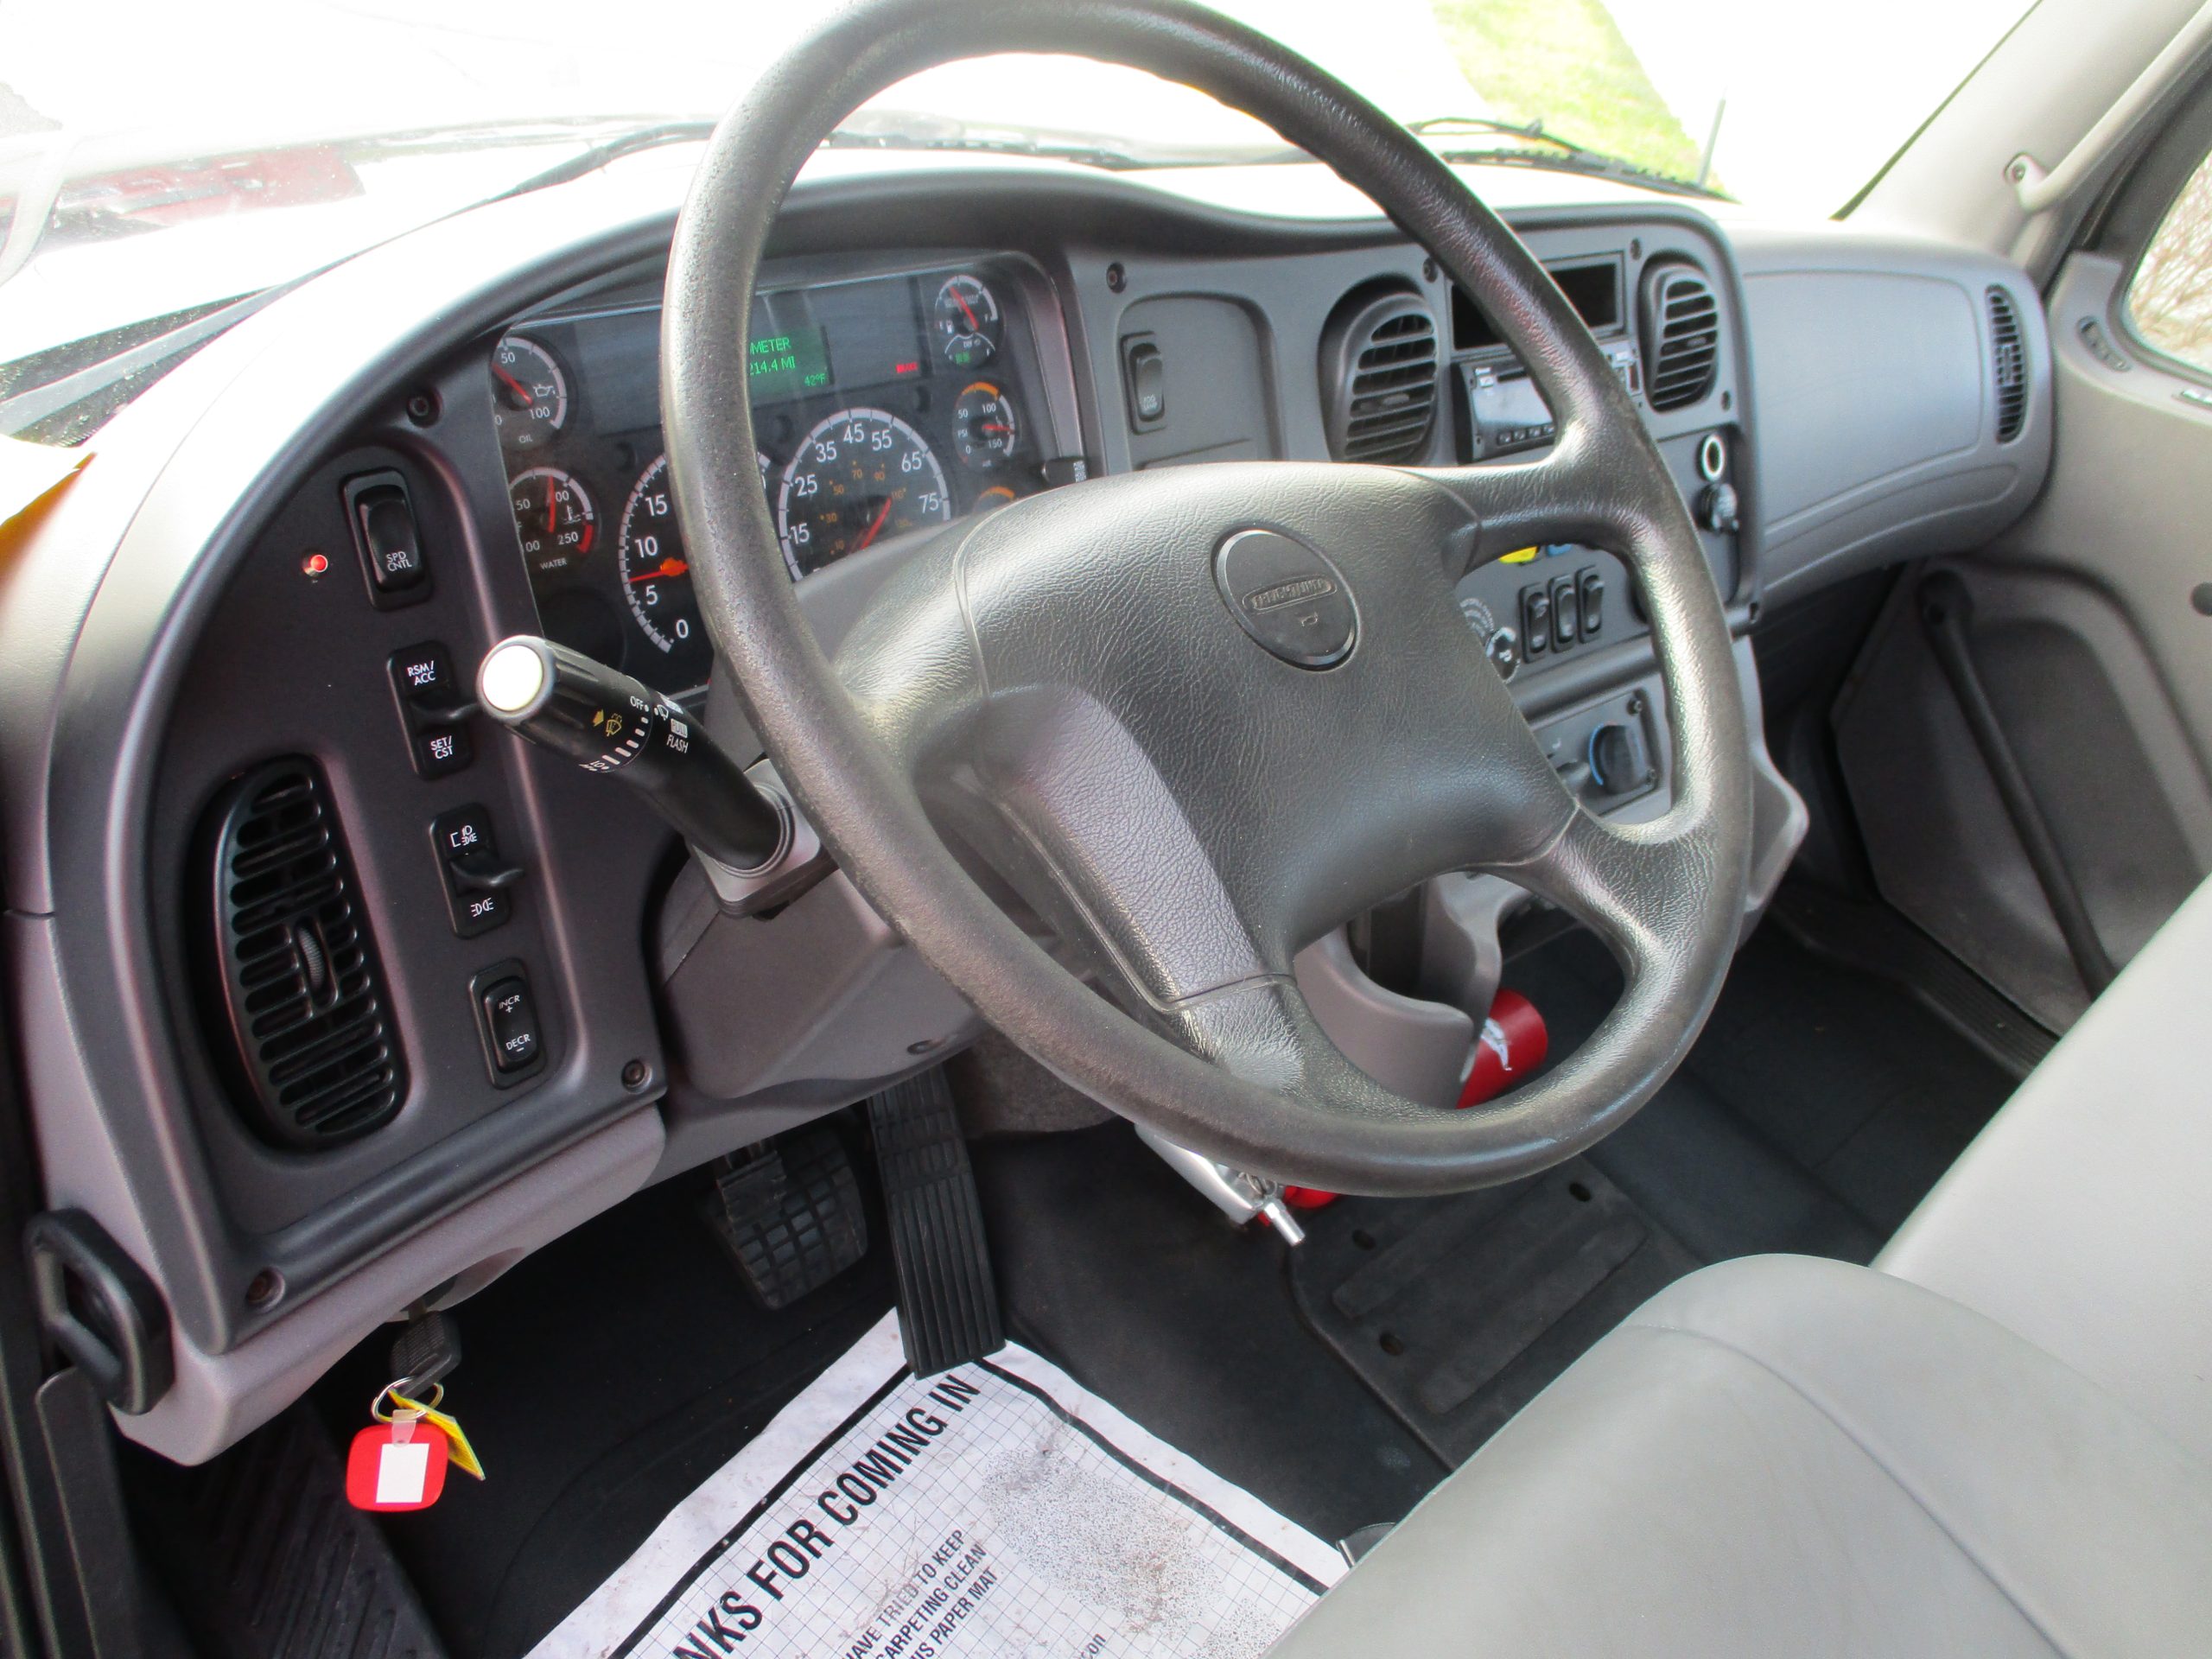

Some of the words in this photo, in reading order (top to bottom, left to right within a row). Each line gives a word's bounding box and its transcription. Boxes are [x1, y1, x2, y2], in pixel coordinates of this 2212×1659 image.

[501, 352, 516, 365] 50
[781, 355, 796, 371] MI
[530, 406, 551, 420] 100
[957, 408, 969, 419] 50
[982, 403, 996, 414] 100
[518, 434, 533, 443] OIL
[843, 423, 865, 444] 45
[871, 429, 893, 452] 55
[965, 445, 971, 454] 0
[988, 438, 1002, 449] 150
[816, 441, 837, 463] 35
[901, 451, 922, 473] 65
[852, 469, 863, 479] 70
[795, 474, 817, 497] 25
[833, 484, 844, 495] 50
[645, 493, 668, 517] 15
[918, 492, 940, 513] 75
[826, 512, 837, 524] 30
[557, 531, 578, 545] 250
[790, 523, 810, 544] 15
[634, 537, 658, 558] 10
[385, 550, 407, 563] SPD
[539, 557, 568, 570] WATER
[387, 559, 412, 572] CNTL
[645, 584, 658, 605] 5
[676, 619, 690, 639] 0
[407, 660, 435, 677] RSM/
[415, 671, 435, 685] ACC
[630, 696, 644, 711] OFF
[430, 735, 453, 751] SET/
[666, 734, 689, 753] FLASH
[435, 746, 454, 760] CST
[499, 995, 521, 1009] INCR
[505, 1033, 531, 1050] DECR
[747, 1519, 835, 1601] FOR
[817, 1408, 948, 1526] COMING
[937, 1374, 982, 1412] IN
[944, 1543, 987, 1591] CLEAN
[875, 1582, 919, 1627] TRIED
[914, 1562, 938, 1585] TO
[931, 1529, 965, 1567] KEEP
[929, 1597, 975, 1645] PAPER
[967, 1566, 998, 1600] MAT
